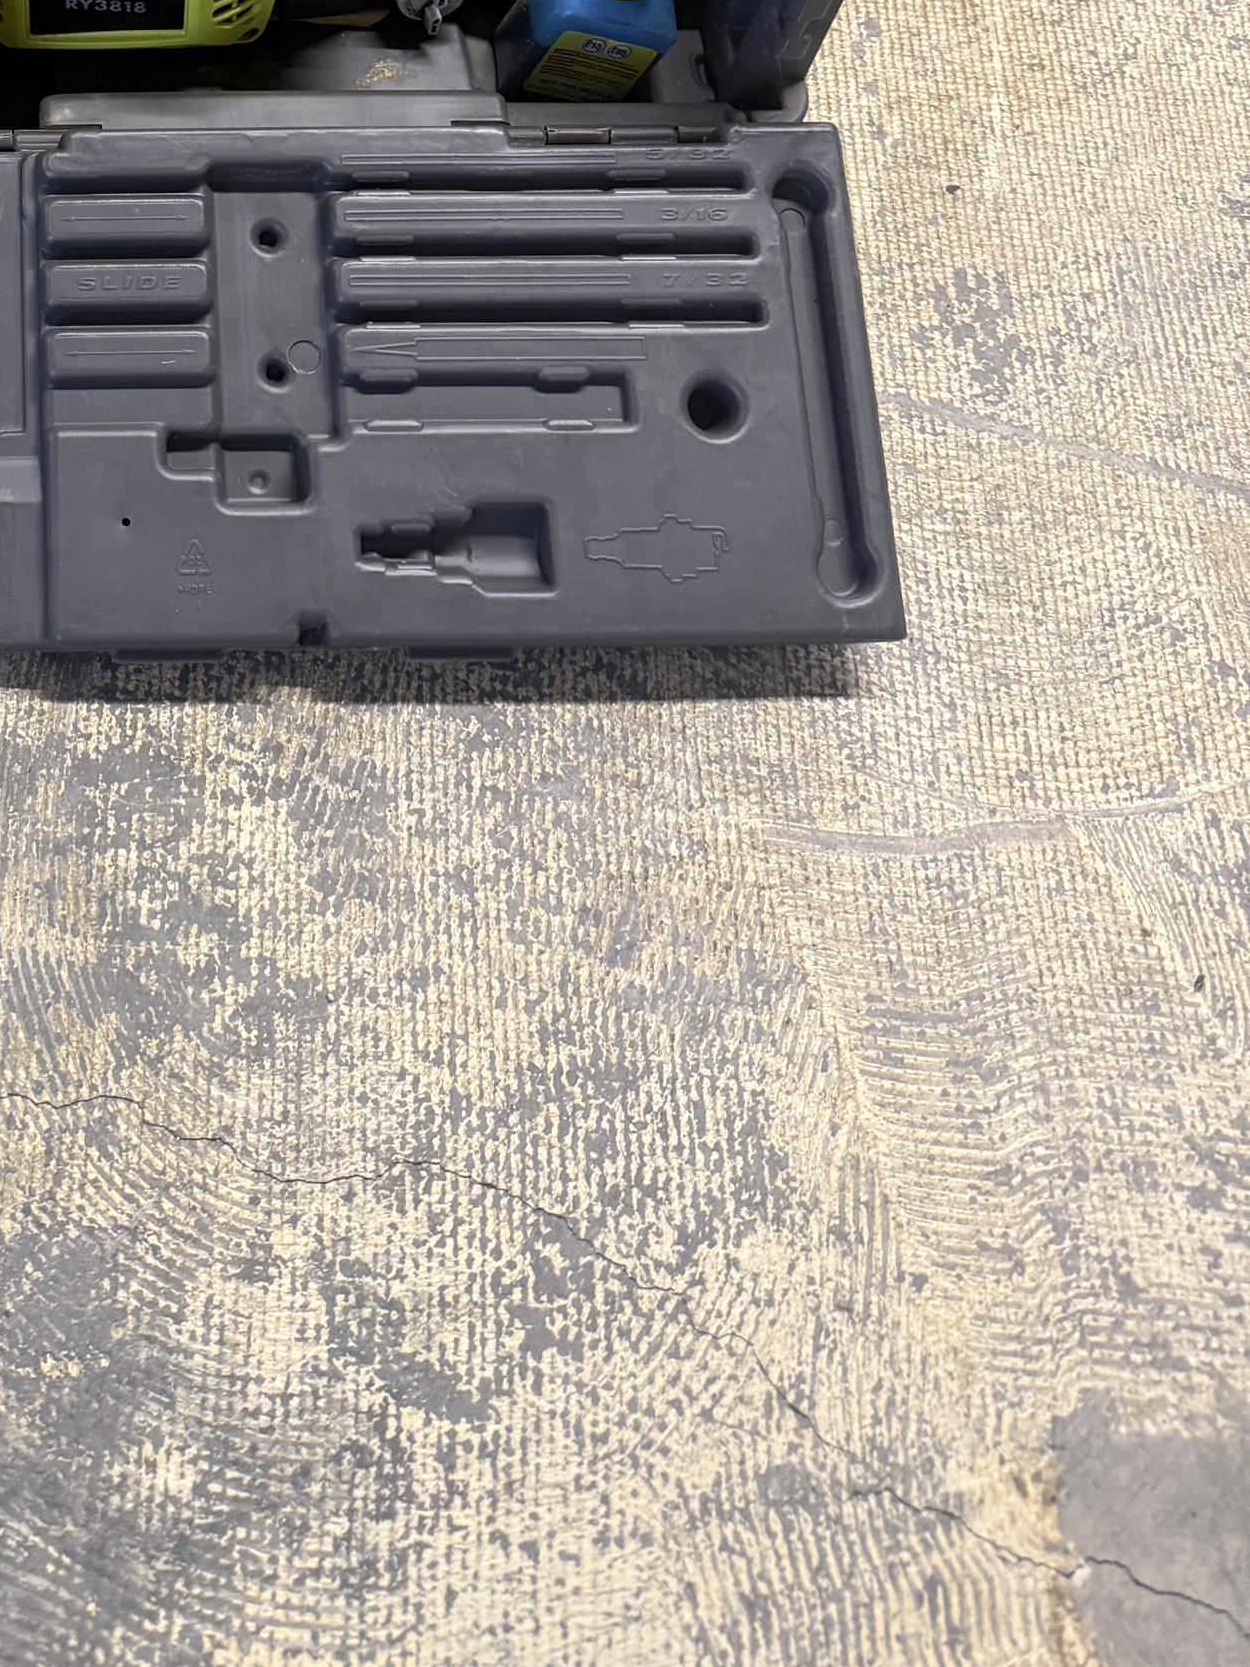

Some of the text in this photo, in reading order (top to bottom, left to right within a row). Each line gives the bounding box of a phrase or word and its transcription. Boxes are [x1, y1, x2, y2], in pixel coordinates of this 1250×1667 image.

[645, 147, 732, 161] 5/32
[660, 207, 728, 222] 3/16
[76, 275, 182, 292] SLIDE
[662, 271, 749, 288] 7/32
